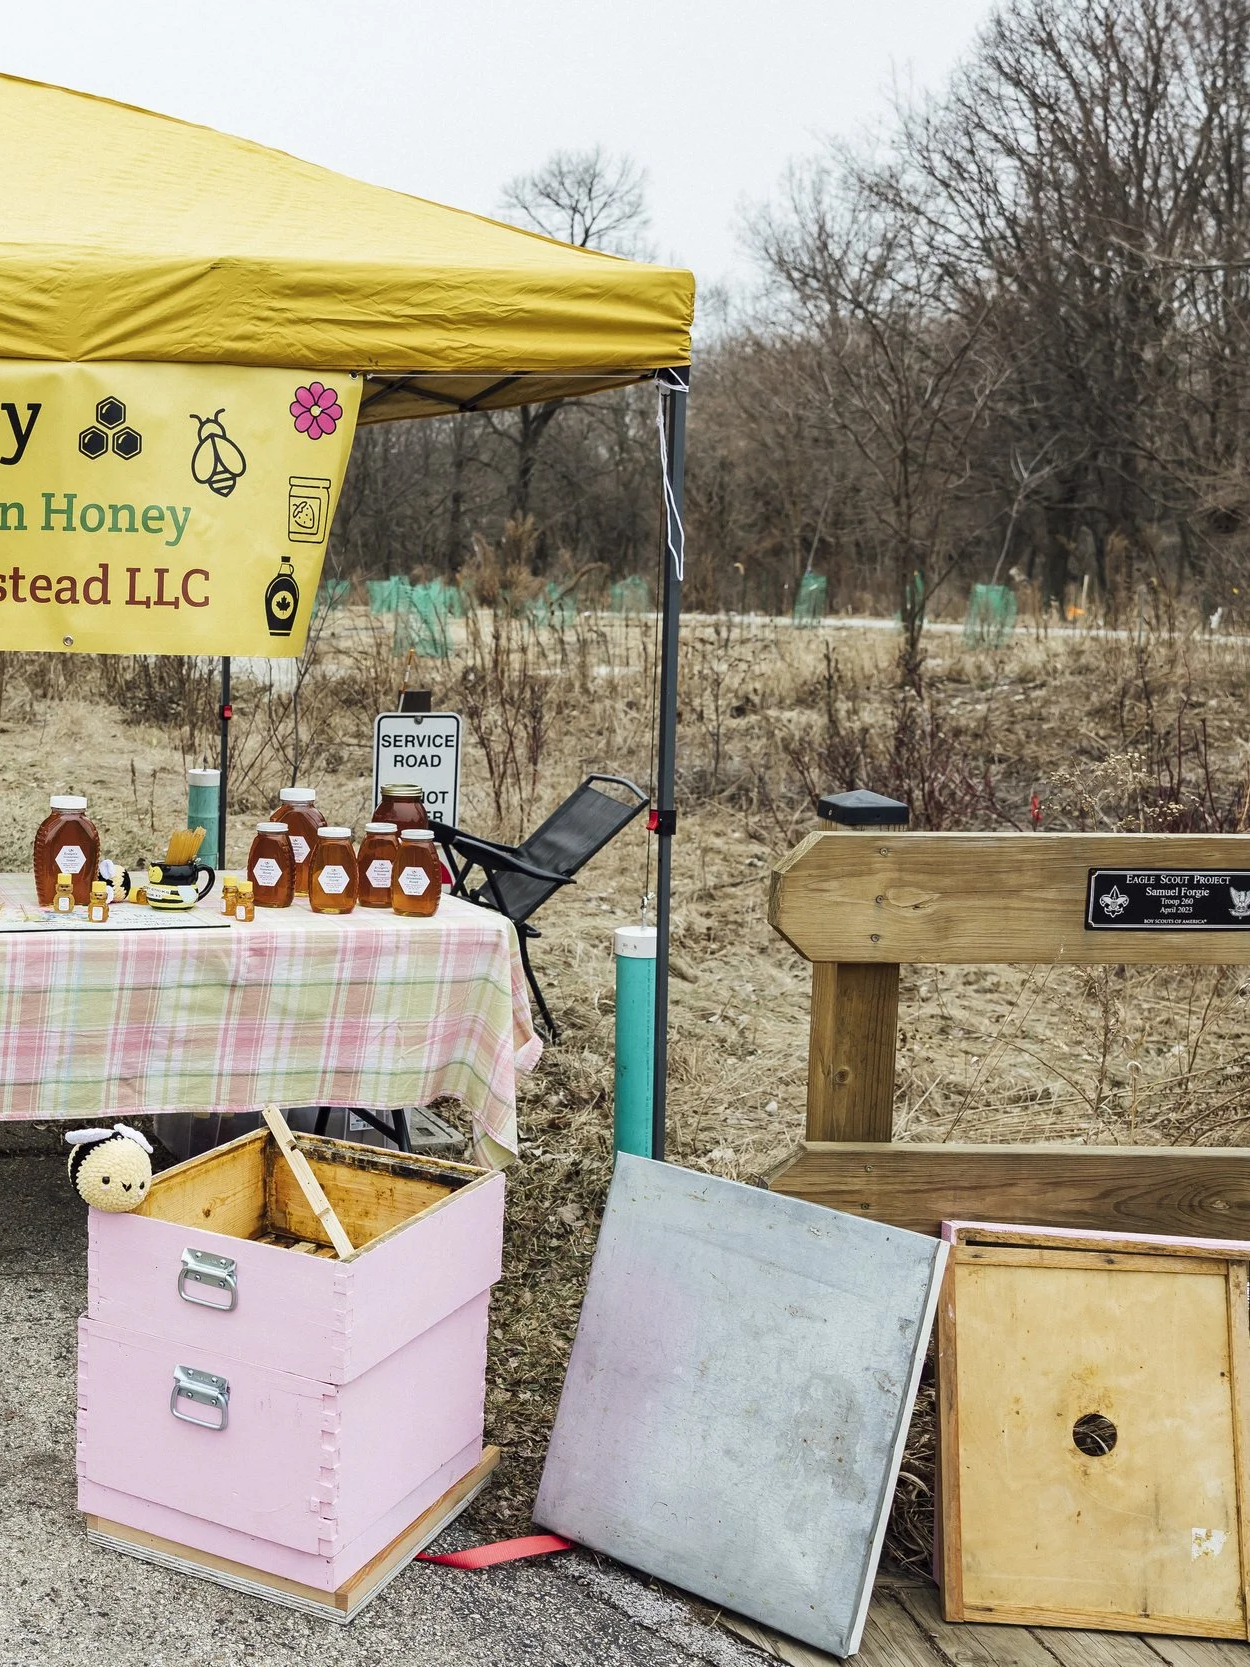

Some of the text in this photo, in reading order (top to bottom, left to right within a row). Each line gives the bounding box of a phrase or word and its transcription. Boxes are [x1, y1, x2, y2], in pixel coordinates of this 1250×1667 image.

[40, 492, 192, 547] Honey
[125, 567, 210, 610] LLC
[381, 734, 455, 748] SERVICE
[393, 754, 442, 768] ROAD
[1126, 874, 1231, 885] EAGLE SCOUT PROJECT
[1145, 887, 1210, 898] Samuel Forgie
[1160, 897, 1180, 905] Troop
[1159, 906, 1193, 914] April 2023
